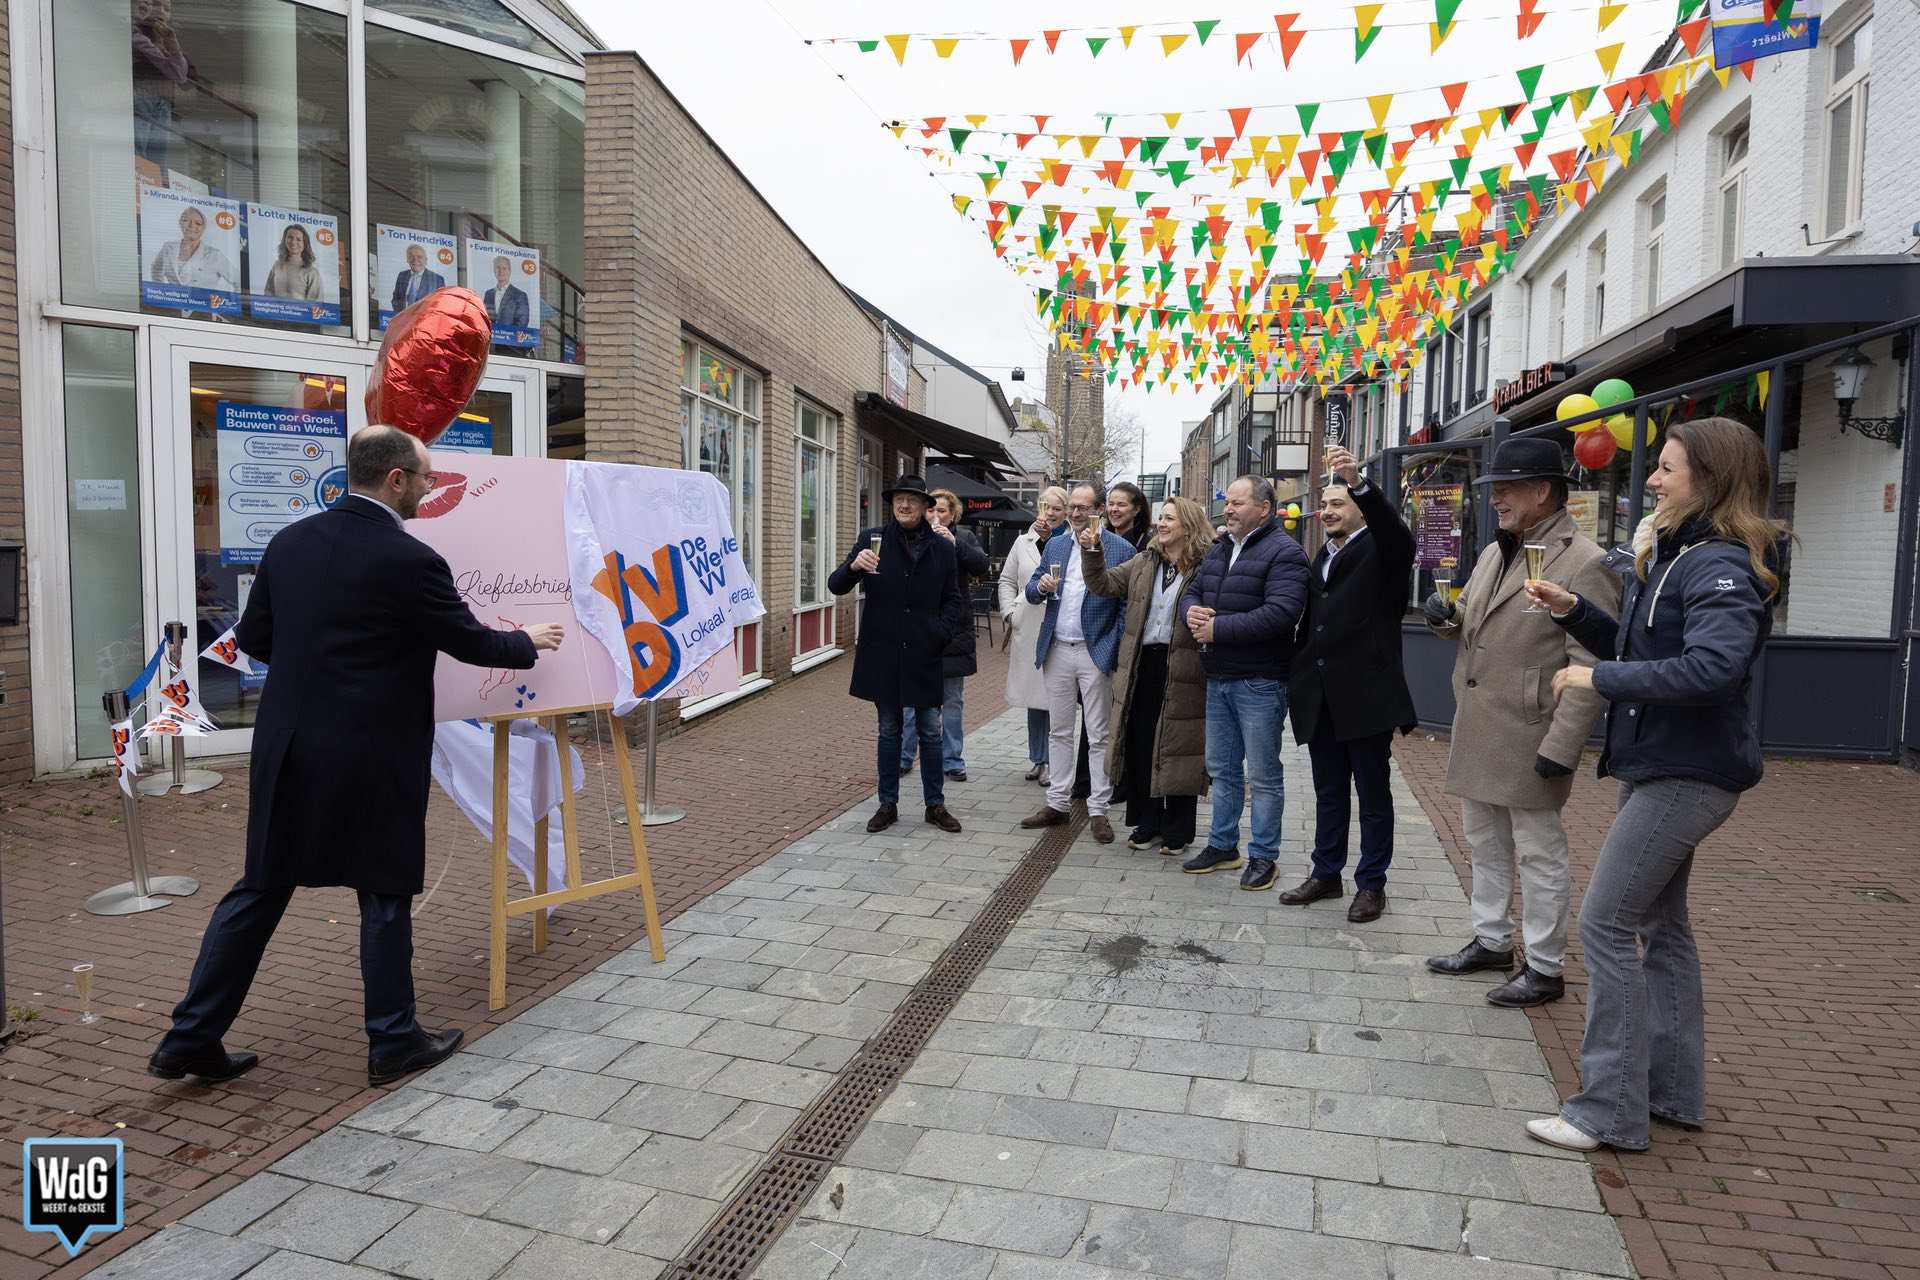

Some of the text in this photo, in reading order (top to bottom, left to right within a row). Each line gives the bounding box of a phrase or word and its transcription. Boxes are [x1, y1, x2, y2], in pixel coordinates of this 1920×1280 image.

[258, 208, 334, 228] Lotte Niederer
[387, 229, 454, 248] Ton Hendriks
[474, 243, 494, 253] Evert
[1526, 362, 1552, 393] BIER
[226, 408, 336, 425] Ruimte voor Groei.
[226, 418, 341, 435] Bouwen aan Weert.
[444, 437, 461, 445] Lage
[469, 477, 498, 498] XOXO
[680, 537, 706, 560] De
[456, 570, 573, 607] Liefdesbrief
[682, 607, 726, 648] Lokaal
